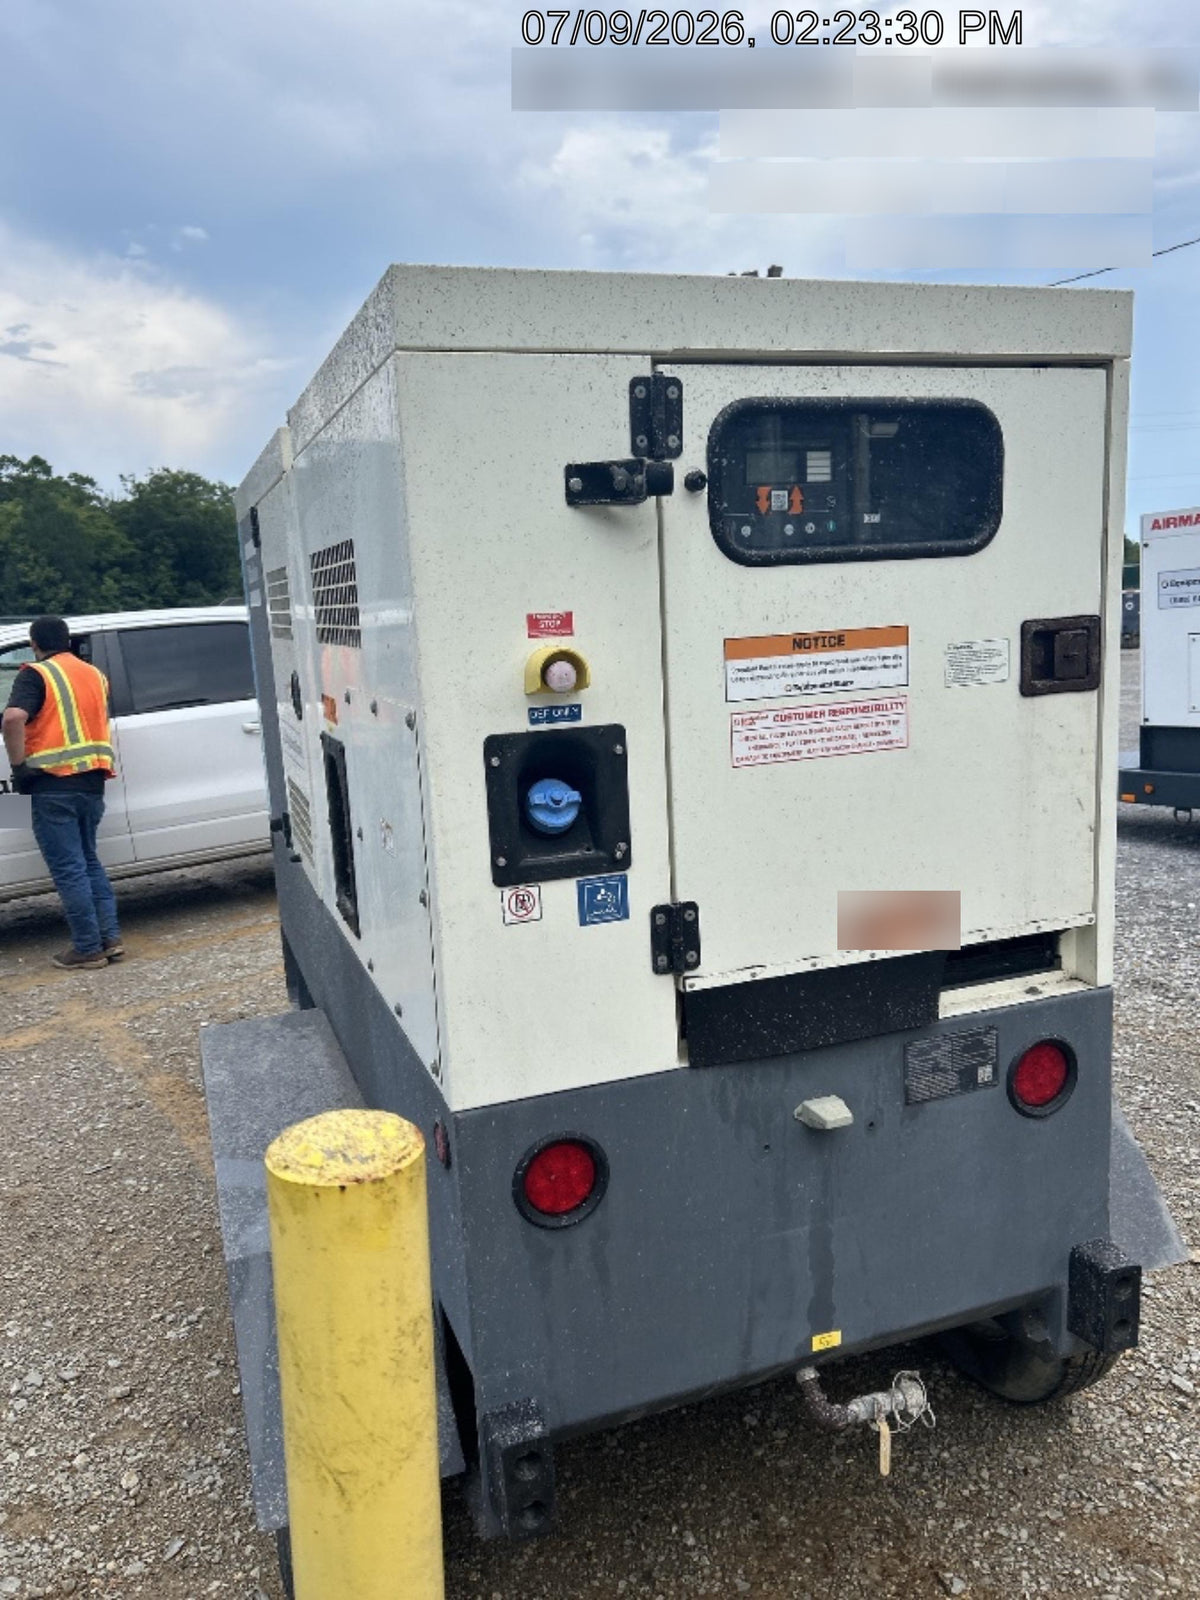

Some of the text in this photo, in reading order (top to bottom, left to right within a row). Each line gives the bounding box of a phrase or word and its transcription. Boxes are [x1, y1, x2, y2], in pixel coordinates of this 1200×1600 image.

[539, 619, 561, 629] STOP
[792, 634, 846, 651] NOTICE
[773, 709, 826, 723] CUSTOMER
[828, 701, 905, 718] RESPONSIBILITY
